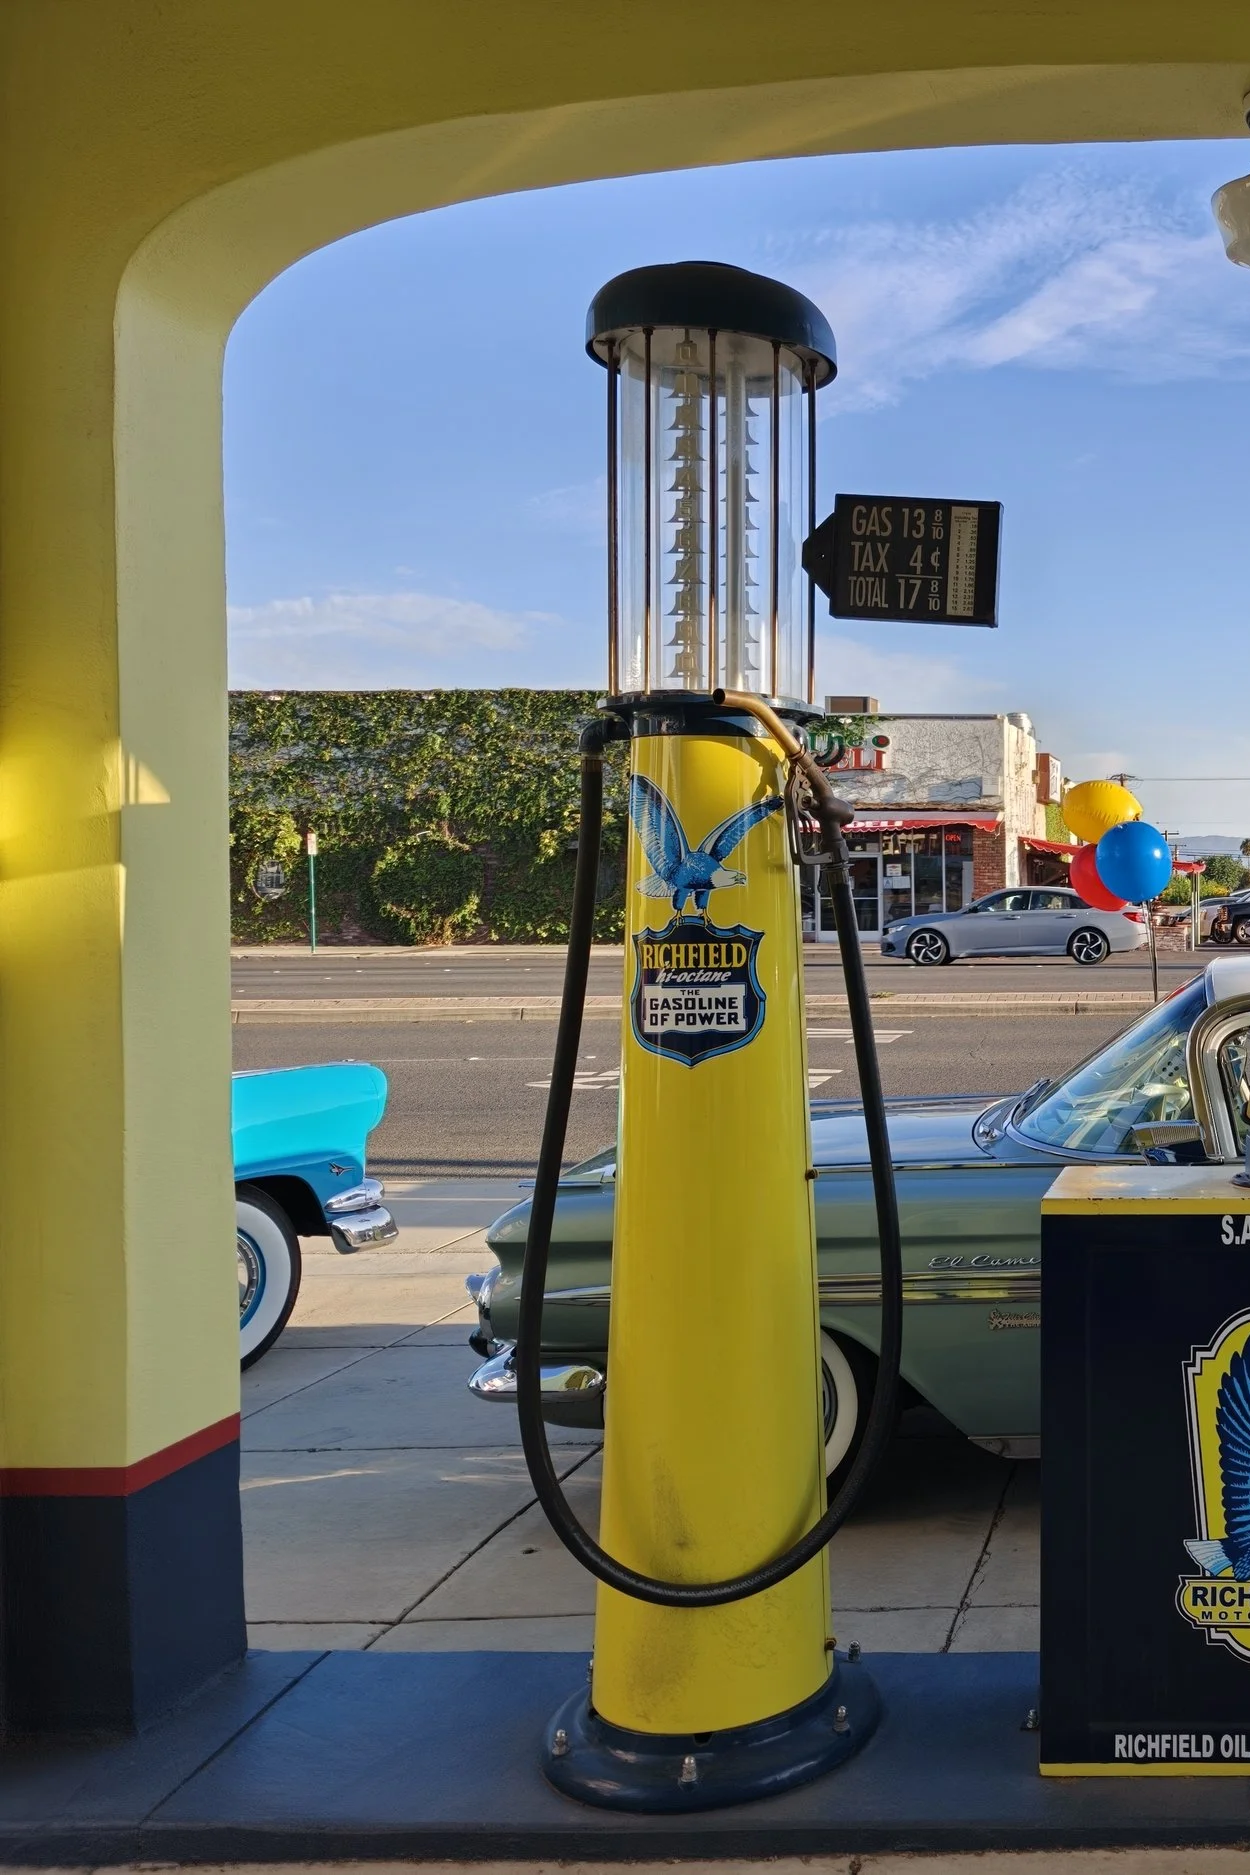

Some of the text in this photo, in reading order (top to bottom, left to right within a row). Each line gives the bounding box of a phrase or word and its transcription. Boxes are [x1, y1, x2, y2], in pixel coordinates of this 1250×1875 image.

[851, 505, 893, 537] GAS
[902, 508, 926, 539] 13
[851, 541, 941, 575] TAX 4 ¢
[848, 576, 889, 609] TOTAL
[898, 579, 923, 610] 17
[945, 834, 961, 842] OPEN
[642, 942, 747, 970] RICHFIELD
[655, 961, 732, 983] hi-octane
[650, 997, 738, 1011] GASOLINE
[650, 1012, 739, 1026] OF POWER
[928, 1256, 963, 1269] El
[1114, 1734, 1214, 1758] RICHFIELD
[1220, 1734, 1250, 1758] OIL
